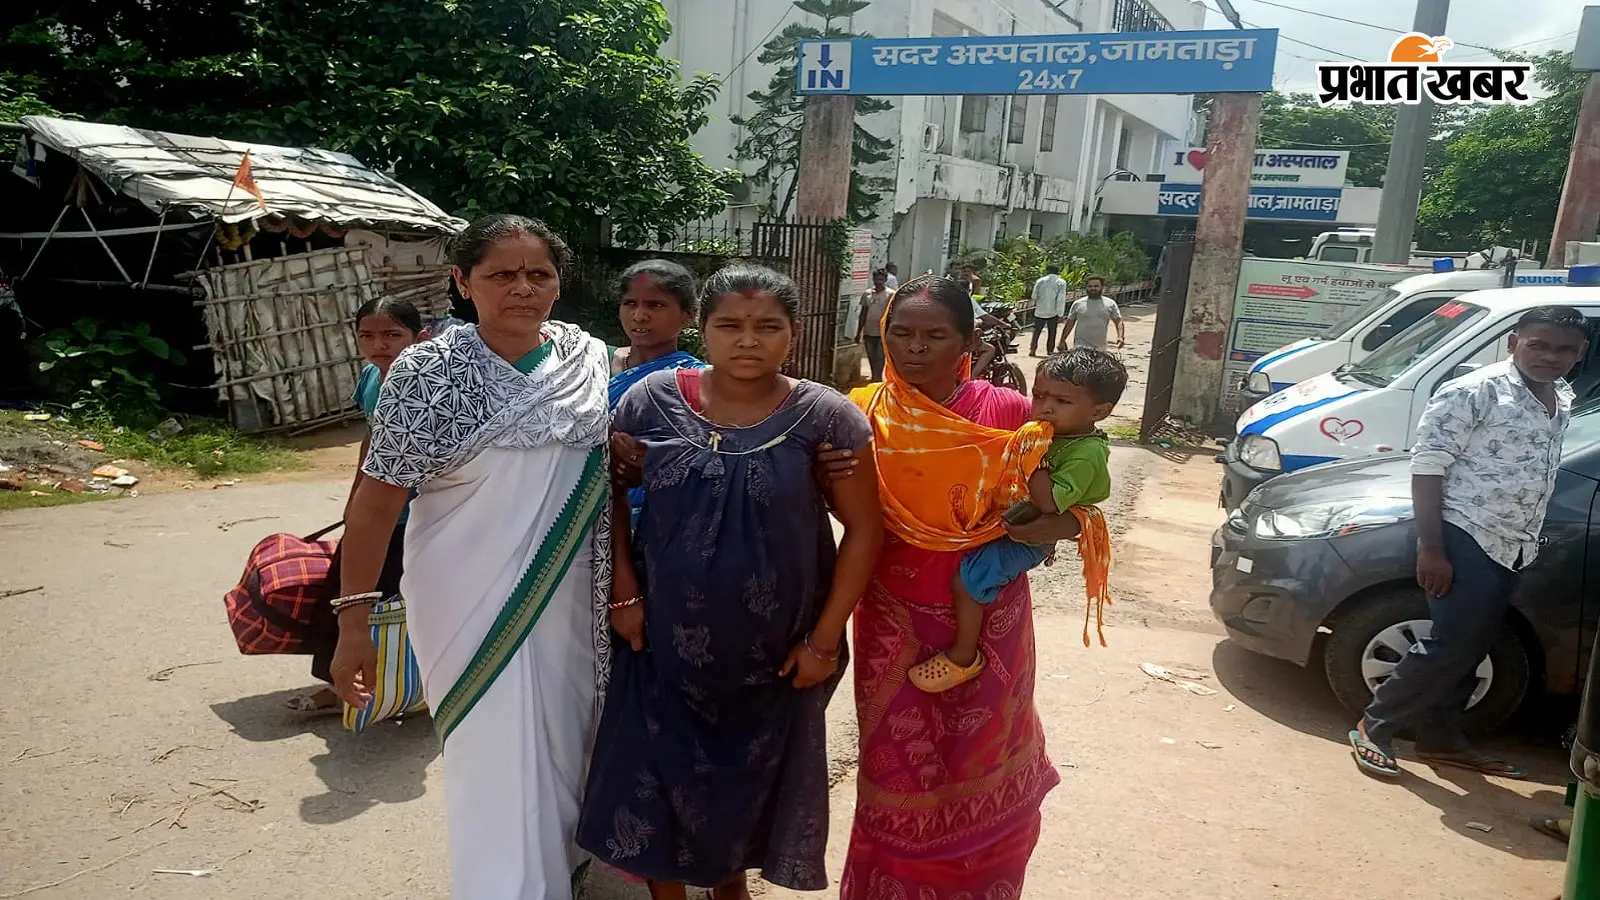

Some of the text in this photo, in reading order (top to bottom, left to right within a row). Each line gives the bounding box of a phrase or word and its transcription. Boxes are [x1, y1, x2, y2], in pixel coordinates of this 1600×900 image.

[872, 45, 942, 66] सदर
[807, 69, 844, 89] IN
[1017, 68, 1084, 91] 24x7
[1266, 154, 1341, 170] अस्पताल
[1159, 191, 1201, 209] सदर
[1516, 275, 1564, 284] QUICK
